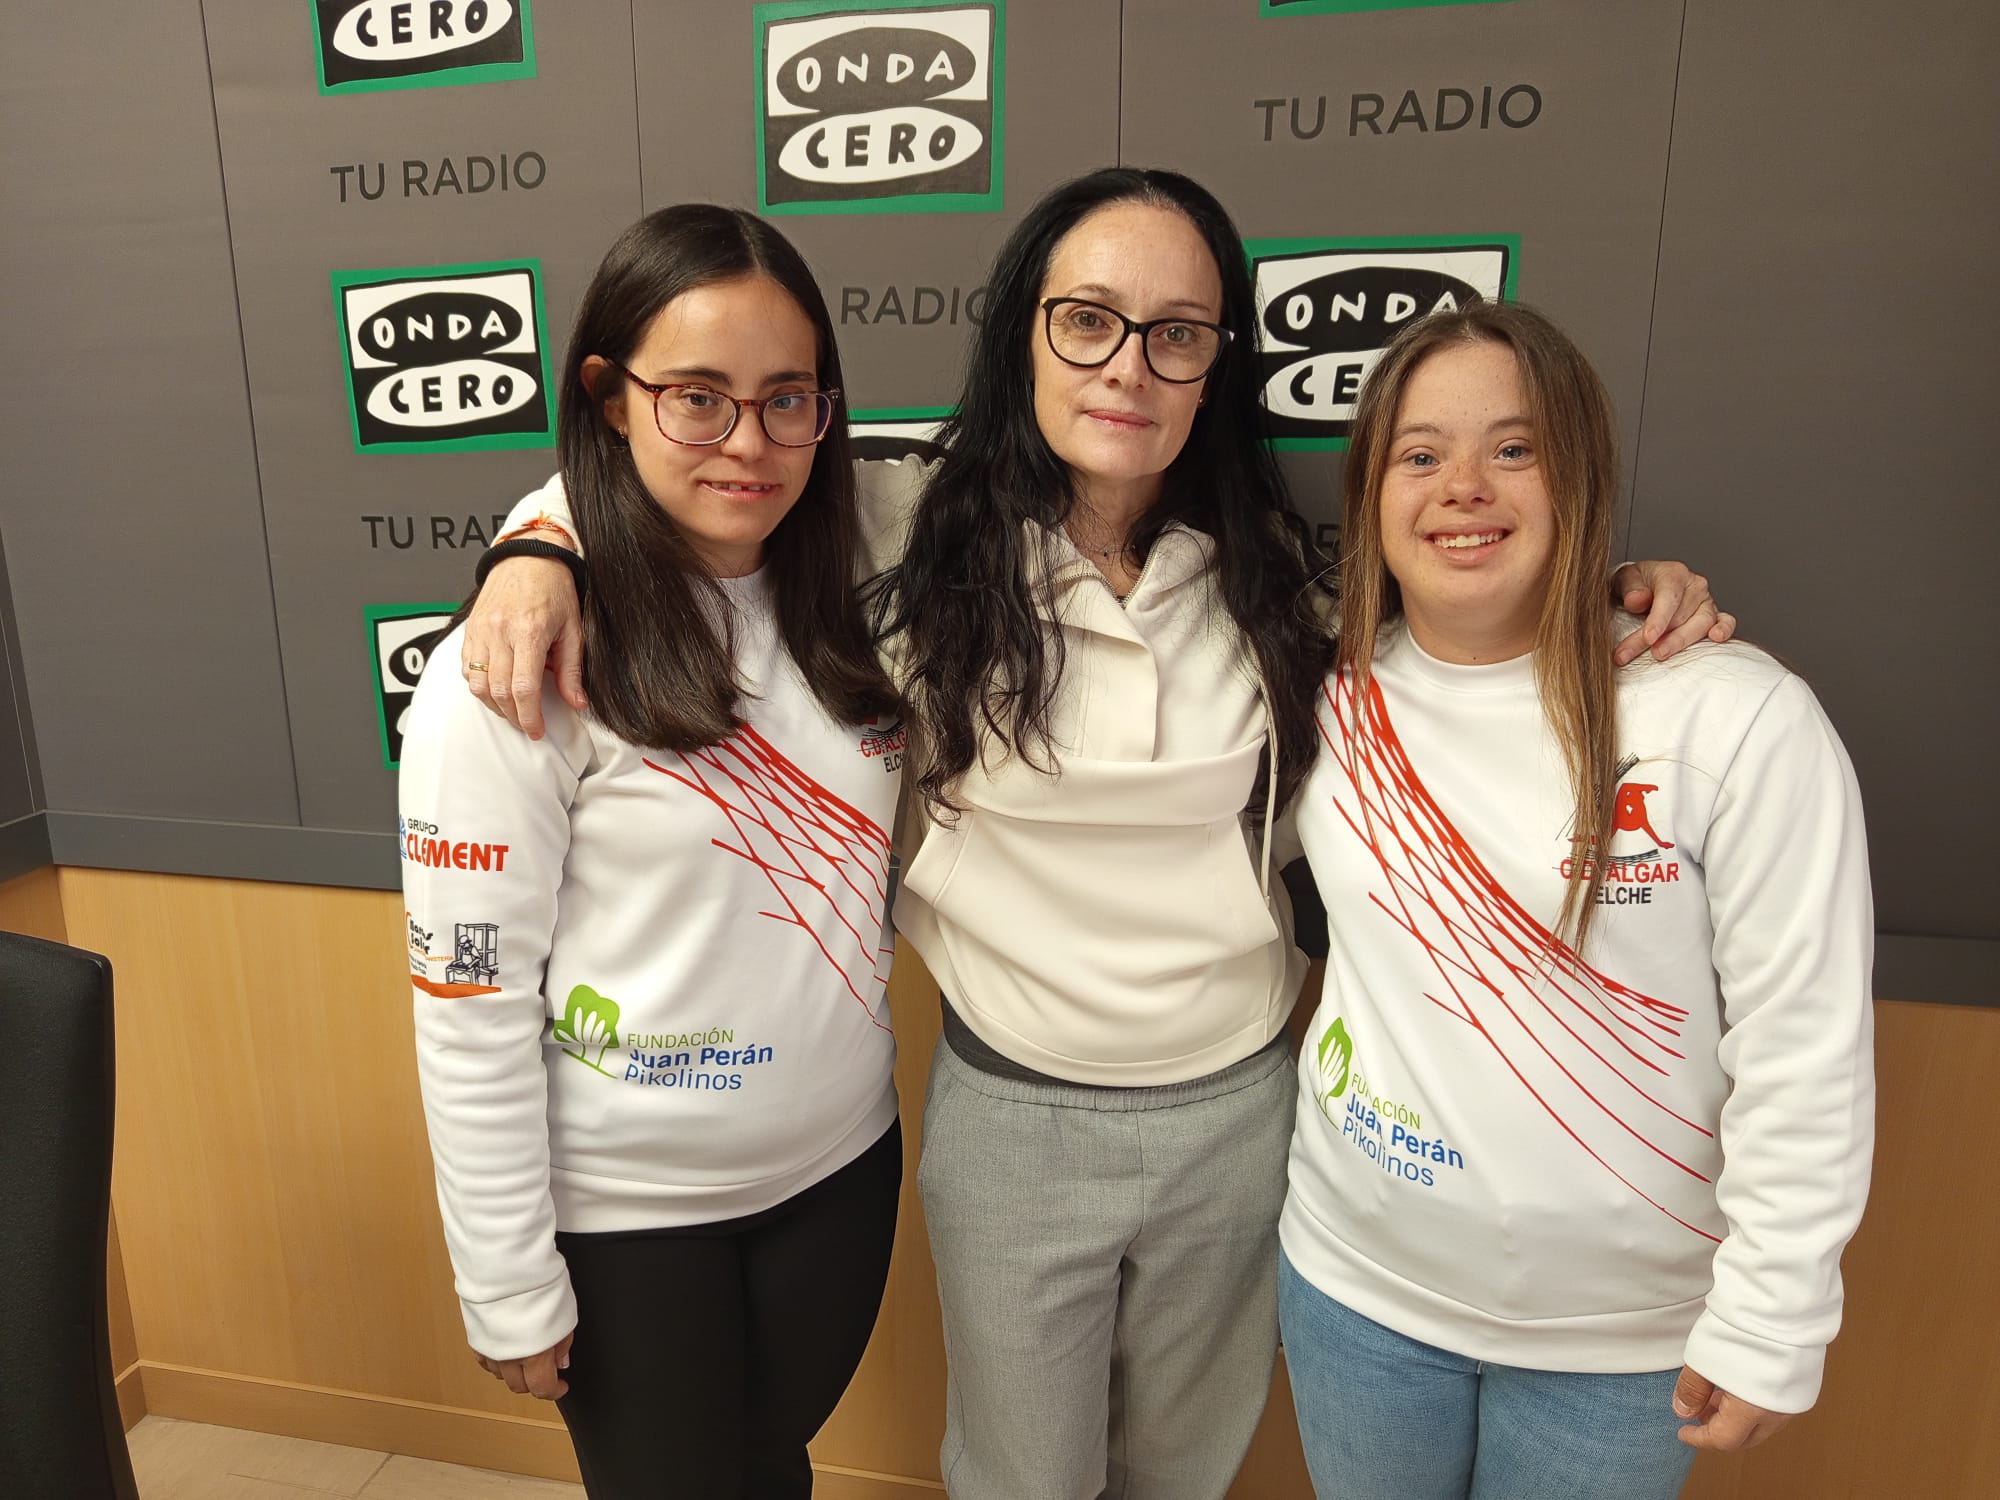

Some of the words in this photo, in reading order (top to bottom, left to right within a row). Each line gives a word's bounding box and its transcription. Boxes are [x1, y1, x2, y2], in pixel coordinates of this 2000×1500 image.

[356, 0, 488, 47] CERO
[796, 50, 955, 93] ONDA
[1254, 96, 1327, 142] TU
[1349, 84, 1543, 137] RADIO
[806, 123, 956, 169] CERO
[330, 163, 386, 203] TU
[402, 151, 546, 198] RADIO
[373, 310, 507, 349] ONDA
[1286, 291, 1459, 330] ONDA
[389, 373, 514, 414] CERO
[361, 516, 415, 549] TU
[407, 818, 439, 835] GRUPO
[407, 833, 509, 872] CLEMENT
[1596, 886, 1652, 905] ELCHE
[627, 1027, 734, 1048] FUNDACIÓN
[629, 1049, 690, 1068] Juan
[700, 1043, 773, 1066] Perán
[624, 1063, 742, 1090] Pikolinos
[1351, 1073, 1421, 1130] FUACIÓN
[1343, 1116, 1434, 1187] Pikolinos
[1391, 1123, 1464, 1170] Perán
